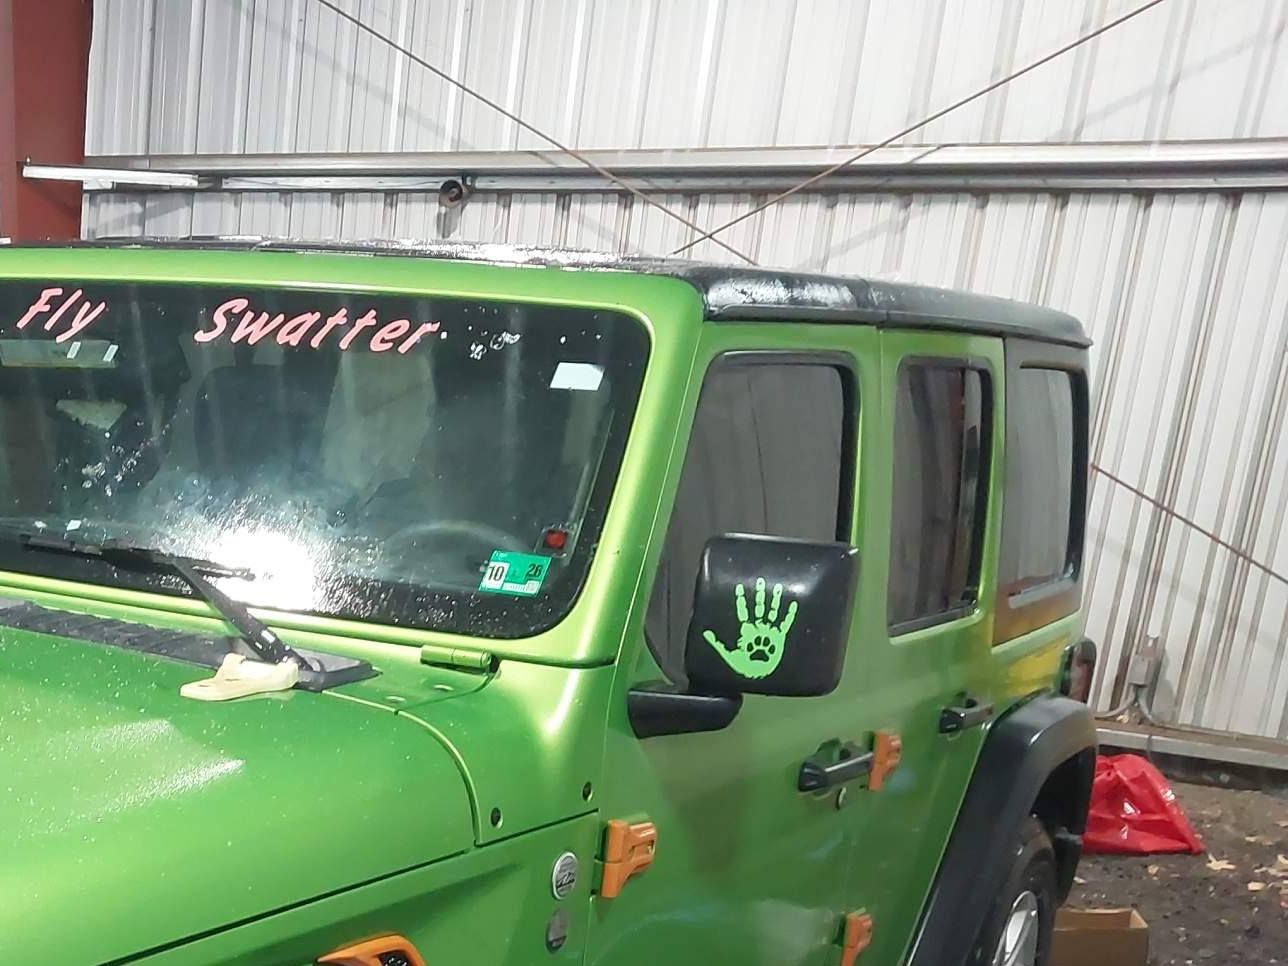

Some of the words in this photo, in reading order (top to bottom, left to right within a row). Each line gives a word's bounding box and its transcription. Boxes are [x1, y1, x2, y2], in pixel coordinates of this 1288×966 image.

[16, 286, 108, 344] Fly
[193, 297, 441, 355] Swatter
[487, 565, 505, 582] 10
[525, 563, 543, 578] 26
